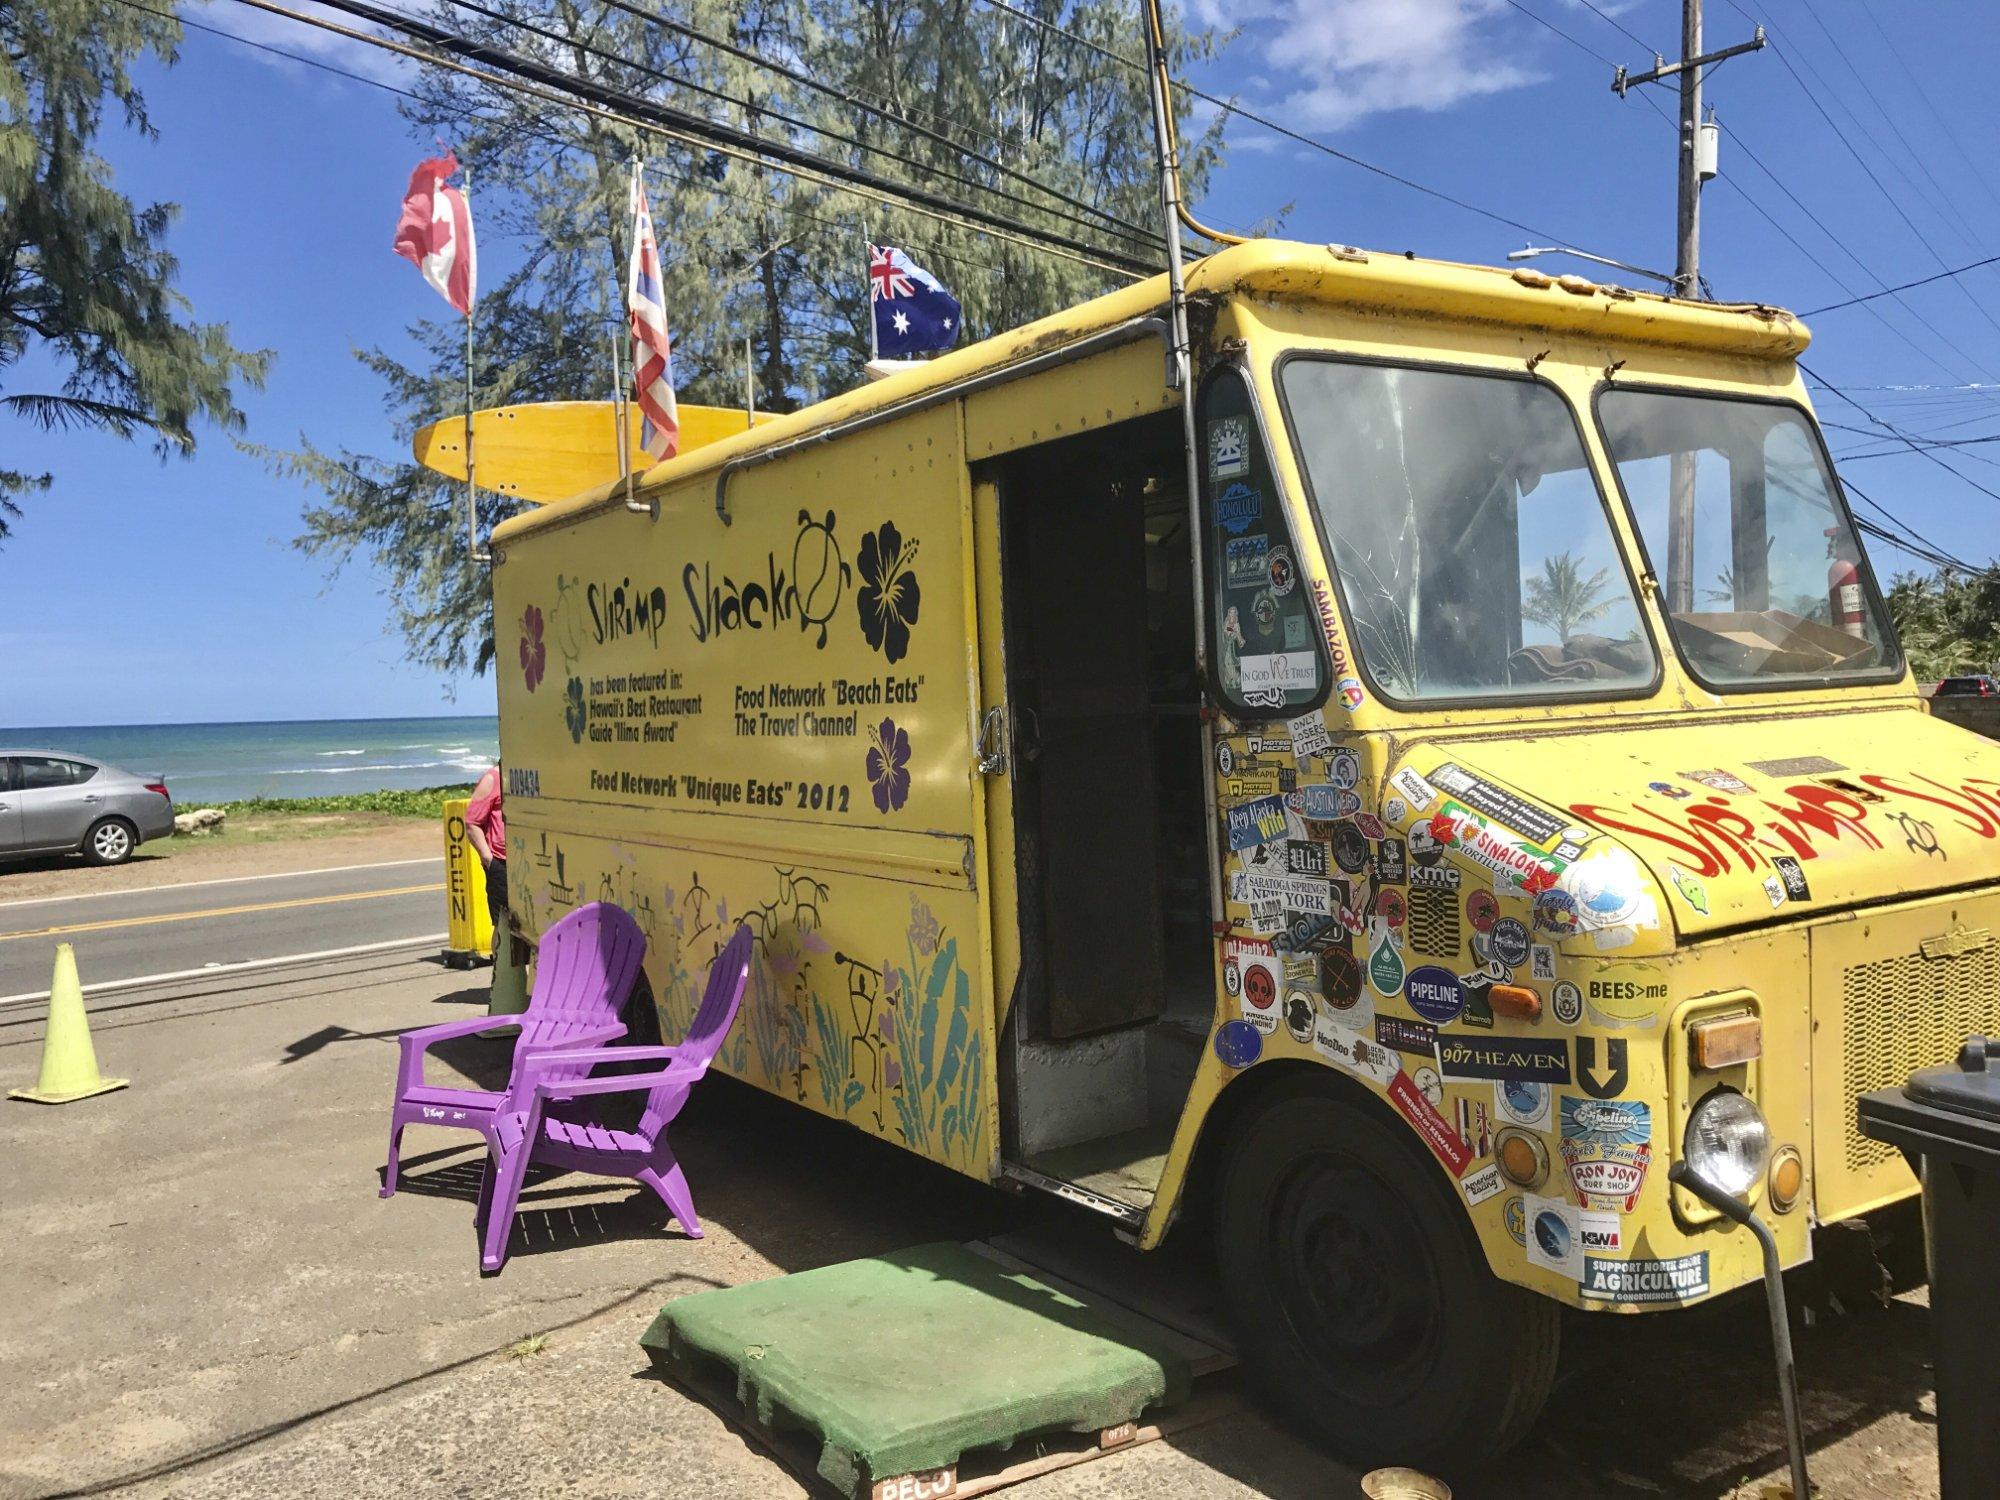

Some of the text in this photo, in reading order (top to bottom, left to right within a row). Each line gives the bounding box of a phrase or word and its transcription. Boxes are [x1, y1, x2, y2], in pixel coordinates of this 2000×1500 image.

[1313, 578, 1349, 677] SAMBAZON
[590, 669, 683, 696] has been featured in:
[590, 694, 703, 719] Hawaii's Best Restaurant
[735, 685, 765, 711] Food
[769, 681, 826, 708] Network
[589, 722, 613, 743] Guide
[735, 710, 858, 737] The Travel Channel
[1292, 723, 1326, 743] LOSERS
[1294, 714, 1316, 731] ONLY
[1296, 736, 1328, 755] LITTER
[509, 768, 541, 797] 009434
[590, 769, 618, 793] Food
[621, 771, 677, 798] Network
[797, 782, 850, 813] 2012
[1400, 778, 1422, 803] Racing
[1402, 771, 1433, 801] American
[1306, 789, 1335, 812] AUSTIN
[1335, 792, 1358, 811] WEIRD
[1467, 789, 1503, 811] Played
[1501, 808, 1513, 817] in
[1476, 783, 1507, 802] Made
[1507, 799, 1519, 809] in
[1229, 801, 1275, 830] Keep Alaska
[1257, 809, 1287, 840] Wild
[1460, 844, 1514, 878] TORTILLAS
[1477, 832, 1538, 878] SINALOA
[447, 815, 467, 923] OPEN
[1249, 876, 1327, 894] SARATOGA SPRINGS
[1285, 892, 1326, 911] YORK
[1410, 981, 1459, 1004] PIPELINE
[1442, 1048, 1567, 1070] 907 HEAVEN
[1397, 1086, 1424, 1119] FRIENDS
[1464, 1169, 1500, 1192] American
[1575, 1165, 1638, 1182] RON JON
[1583, 1180, 1630, 1190] SURF SHOP
[1471, 1180, 1498, 1195] Racing
[1593, 1255, 1701, 1273] SUPPORT NORTH SHORE
[1593, 1266, 1702, 1292] AGRICULTURE
